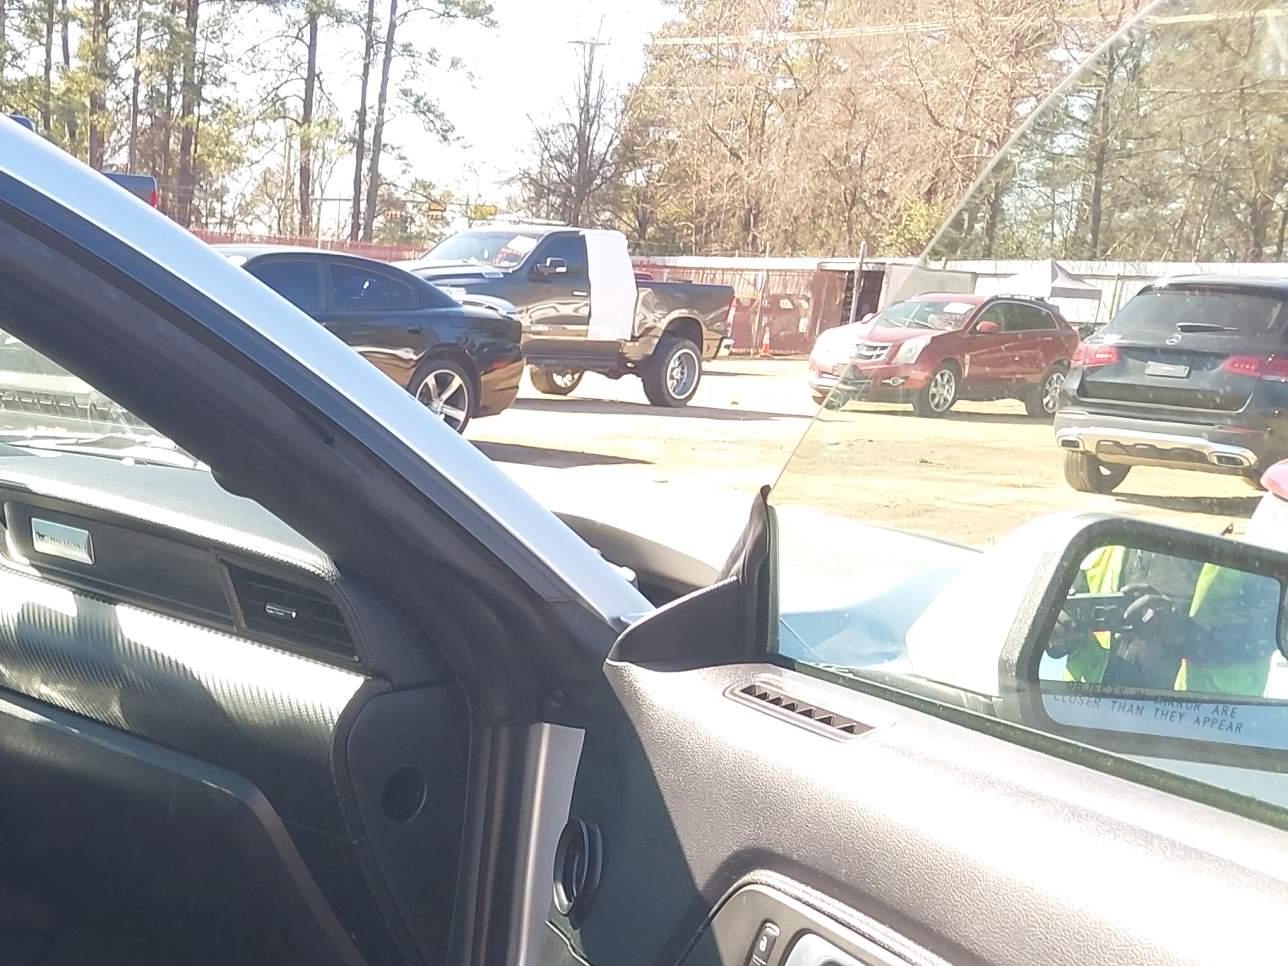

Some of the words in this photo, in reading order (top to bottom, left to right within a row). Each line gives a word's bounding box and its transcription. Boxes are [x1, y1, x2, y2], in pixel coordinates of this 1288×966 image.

[1111, 700, 1145, 716] THAN
[1153, 707, 1186, 722] THEY
[1192, 715, 1244, 735] APPEAR
[1211, 704, 1239, 718] ARE
